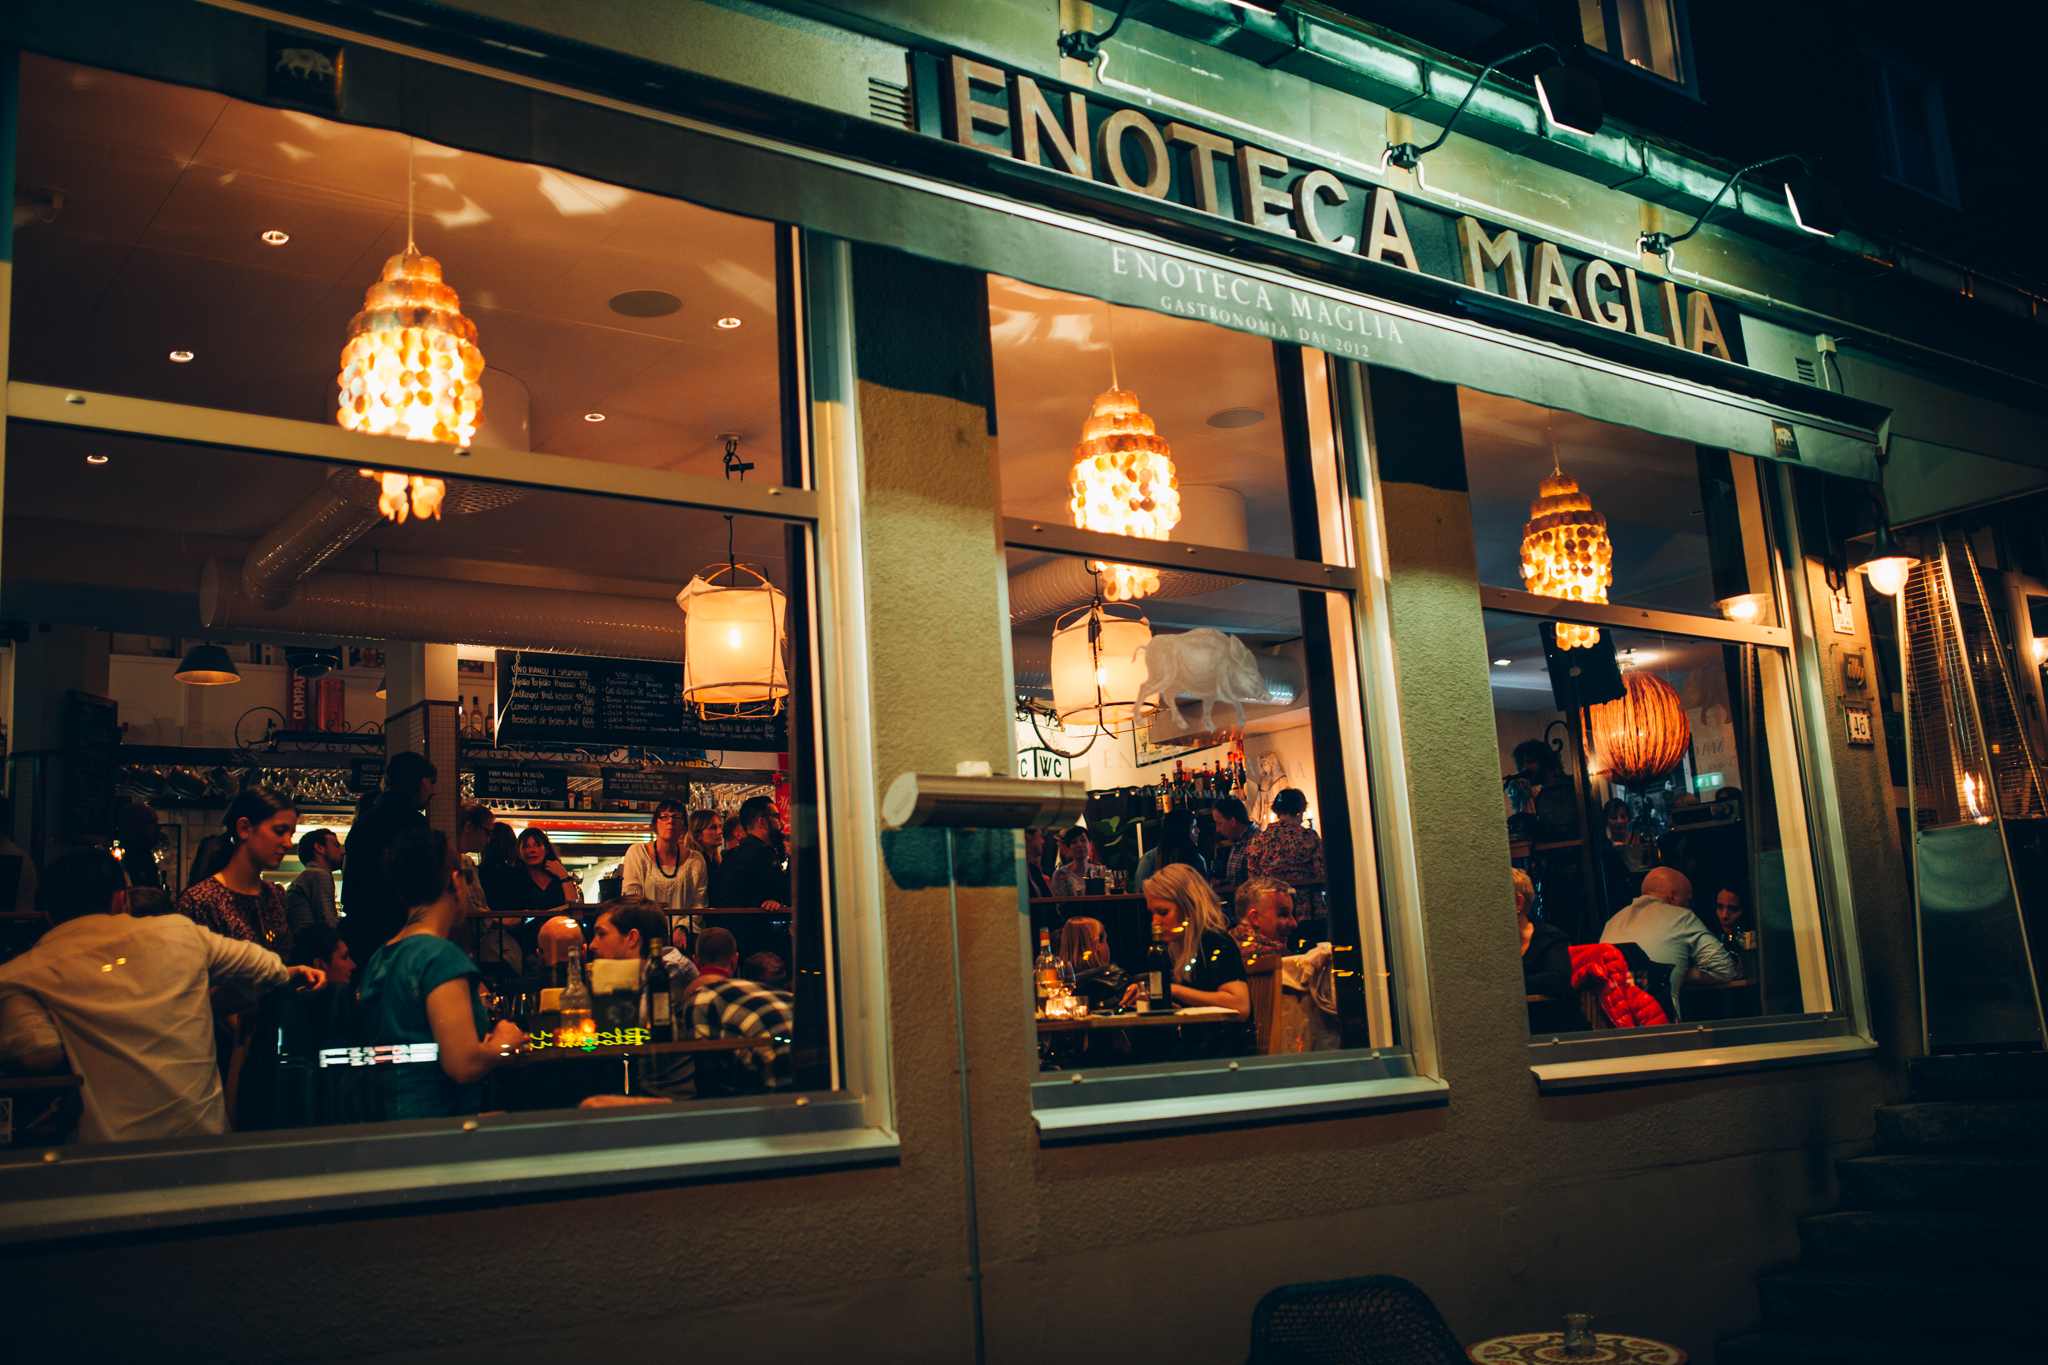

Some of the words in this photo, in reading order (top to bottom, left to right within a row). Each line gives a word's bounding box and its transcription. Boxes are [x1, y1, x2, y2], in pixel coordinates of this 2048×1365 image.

[944, 54, 1420, 272] ENOTECA
[1456, 215, 1732, 362] MAGLIA
[1112, 246, 1273, 311] ENOTECA
[1289, 292, 1403, 344] MAGLIA
[1161, 295, 1289, 338] GASTRONOMIA
[1299, 327, 1328, 346] DAL
[1335, 338, 1370, 358] 2012
[293, 671, 306, 720] CAMPAR
[1854, 716, 1867, 735] 46
[1039, 755, 1062, 779] WC
